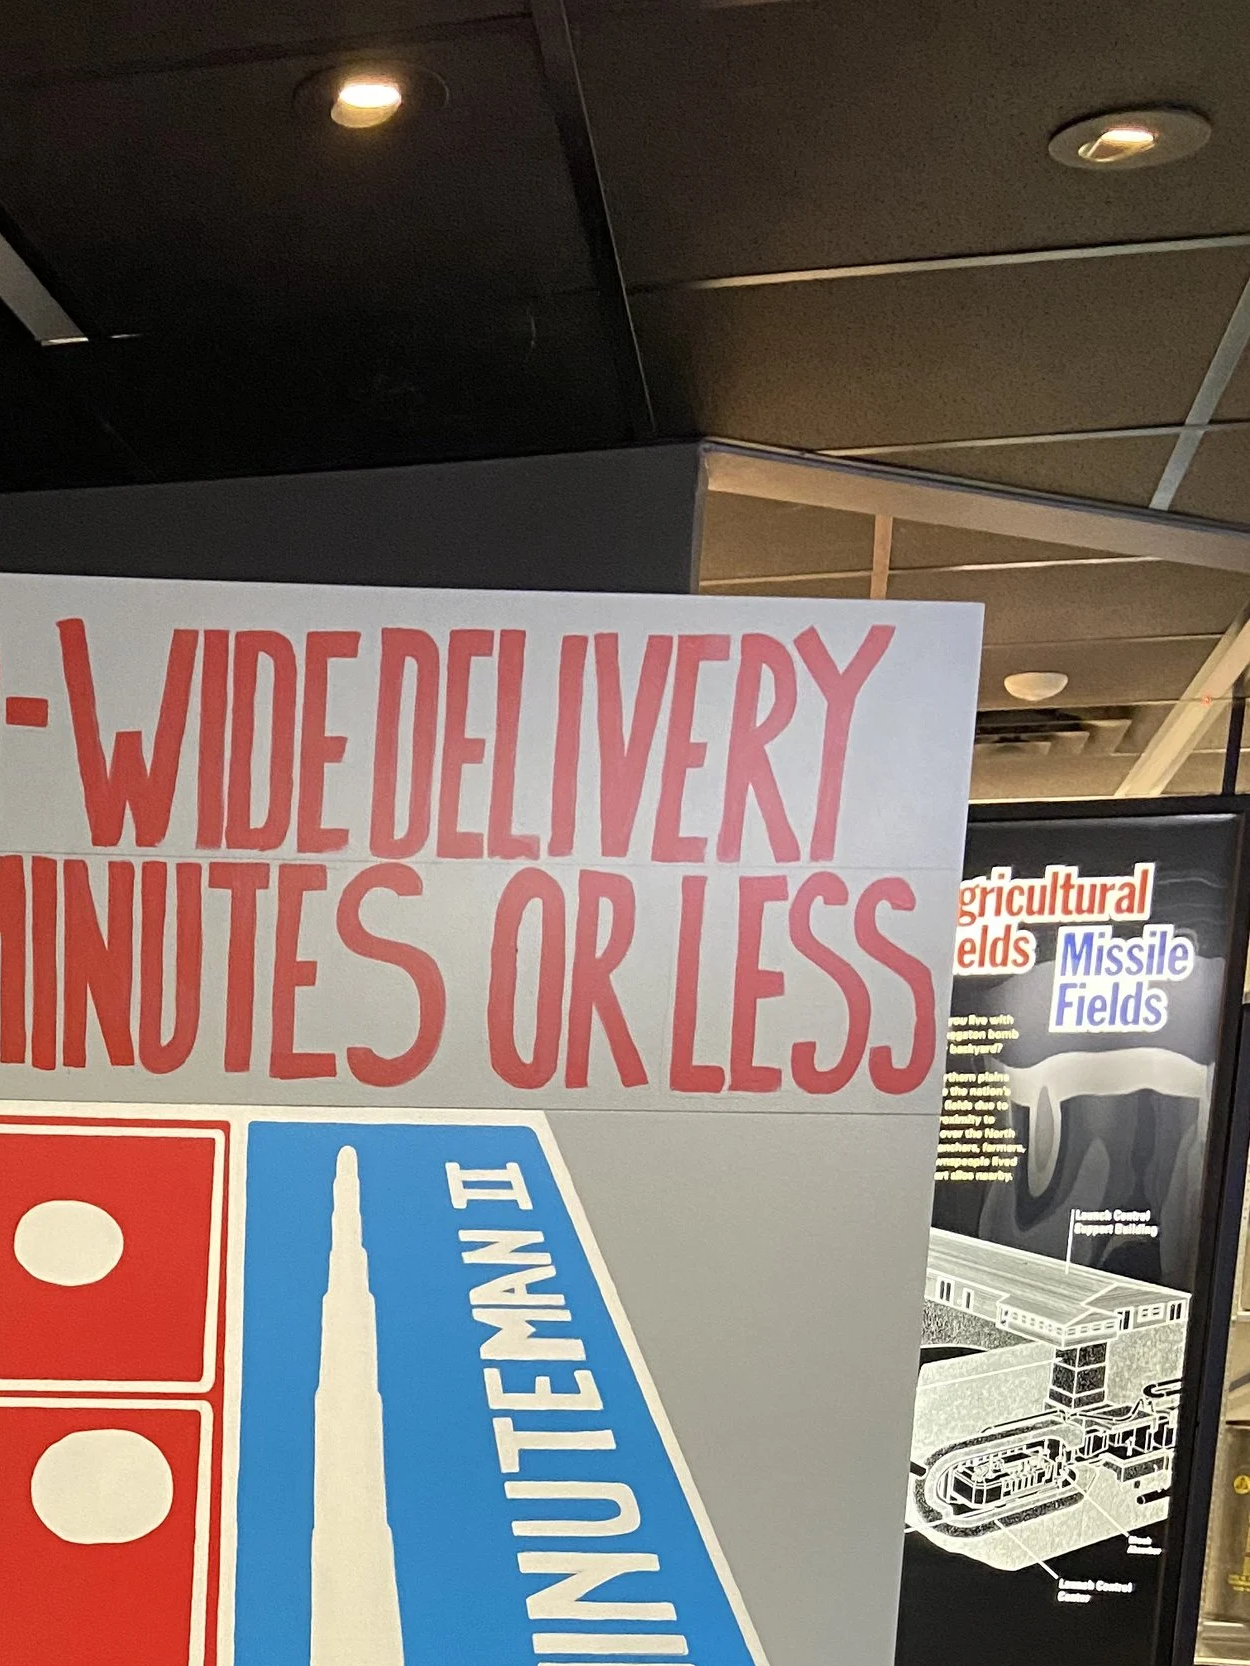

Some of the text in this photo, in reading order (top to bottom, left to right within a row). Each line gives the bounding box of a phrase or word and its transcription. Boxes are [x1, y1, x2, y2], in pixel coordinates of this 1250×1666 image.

[369, 623, 897, 863] DELIVERY
[1060, 930, 1189, 977] Missile
[487, 867, 649, 1090] OR
[669, 871, 937, 1095] LESS
[1054, 981, 1163, 1027] Fields
[989, 1014, 1014, 1026] with
[988, 1028, 1019, 1039] bomb
[950, 1043, 1004, 1055] backyard?
[977, 1071, 1010, 1084] plains
[950, 1086, 968, 1097] the
[996, 1101, 1009, 1110] to
[983, 1115, 996, 1124] to
[964, 1128, 982, 1139] the
[445, 1162, 534, 1210] II
